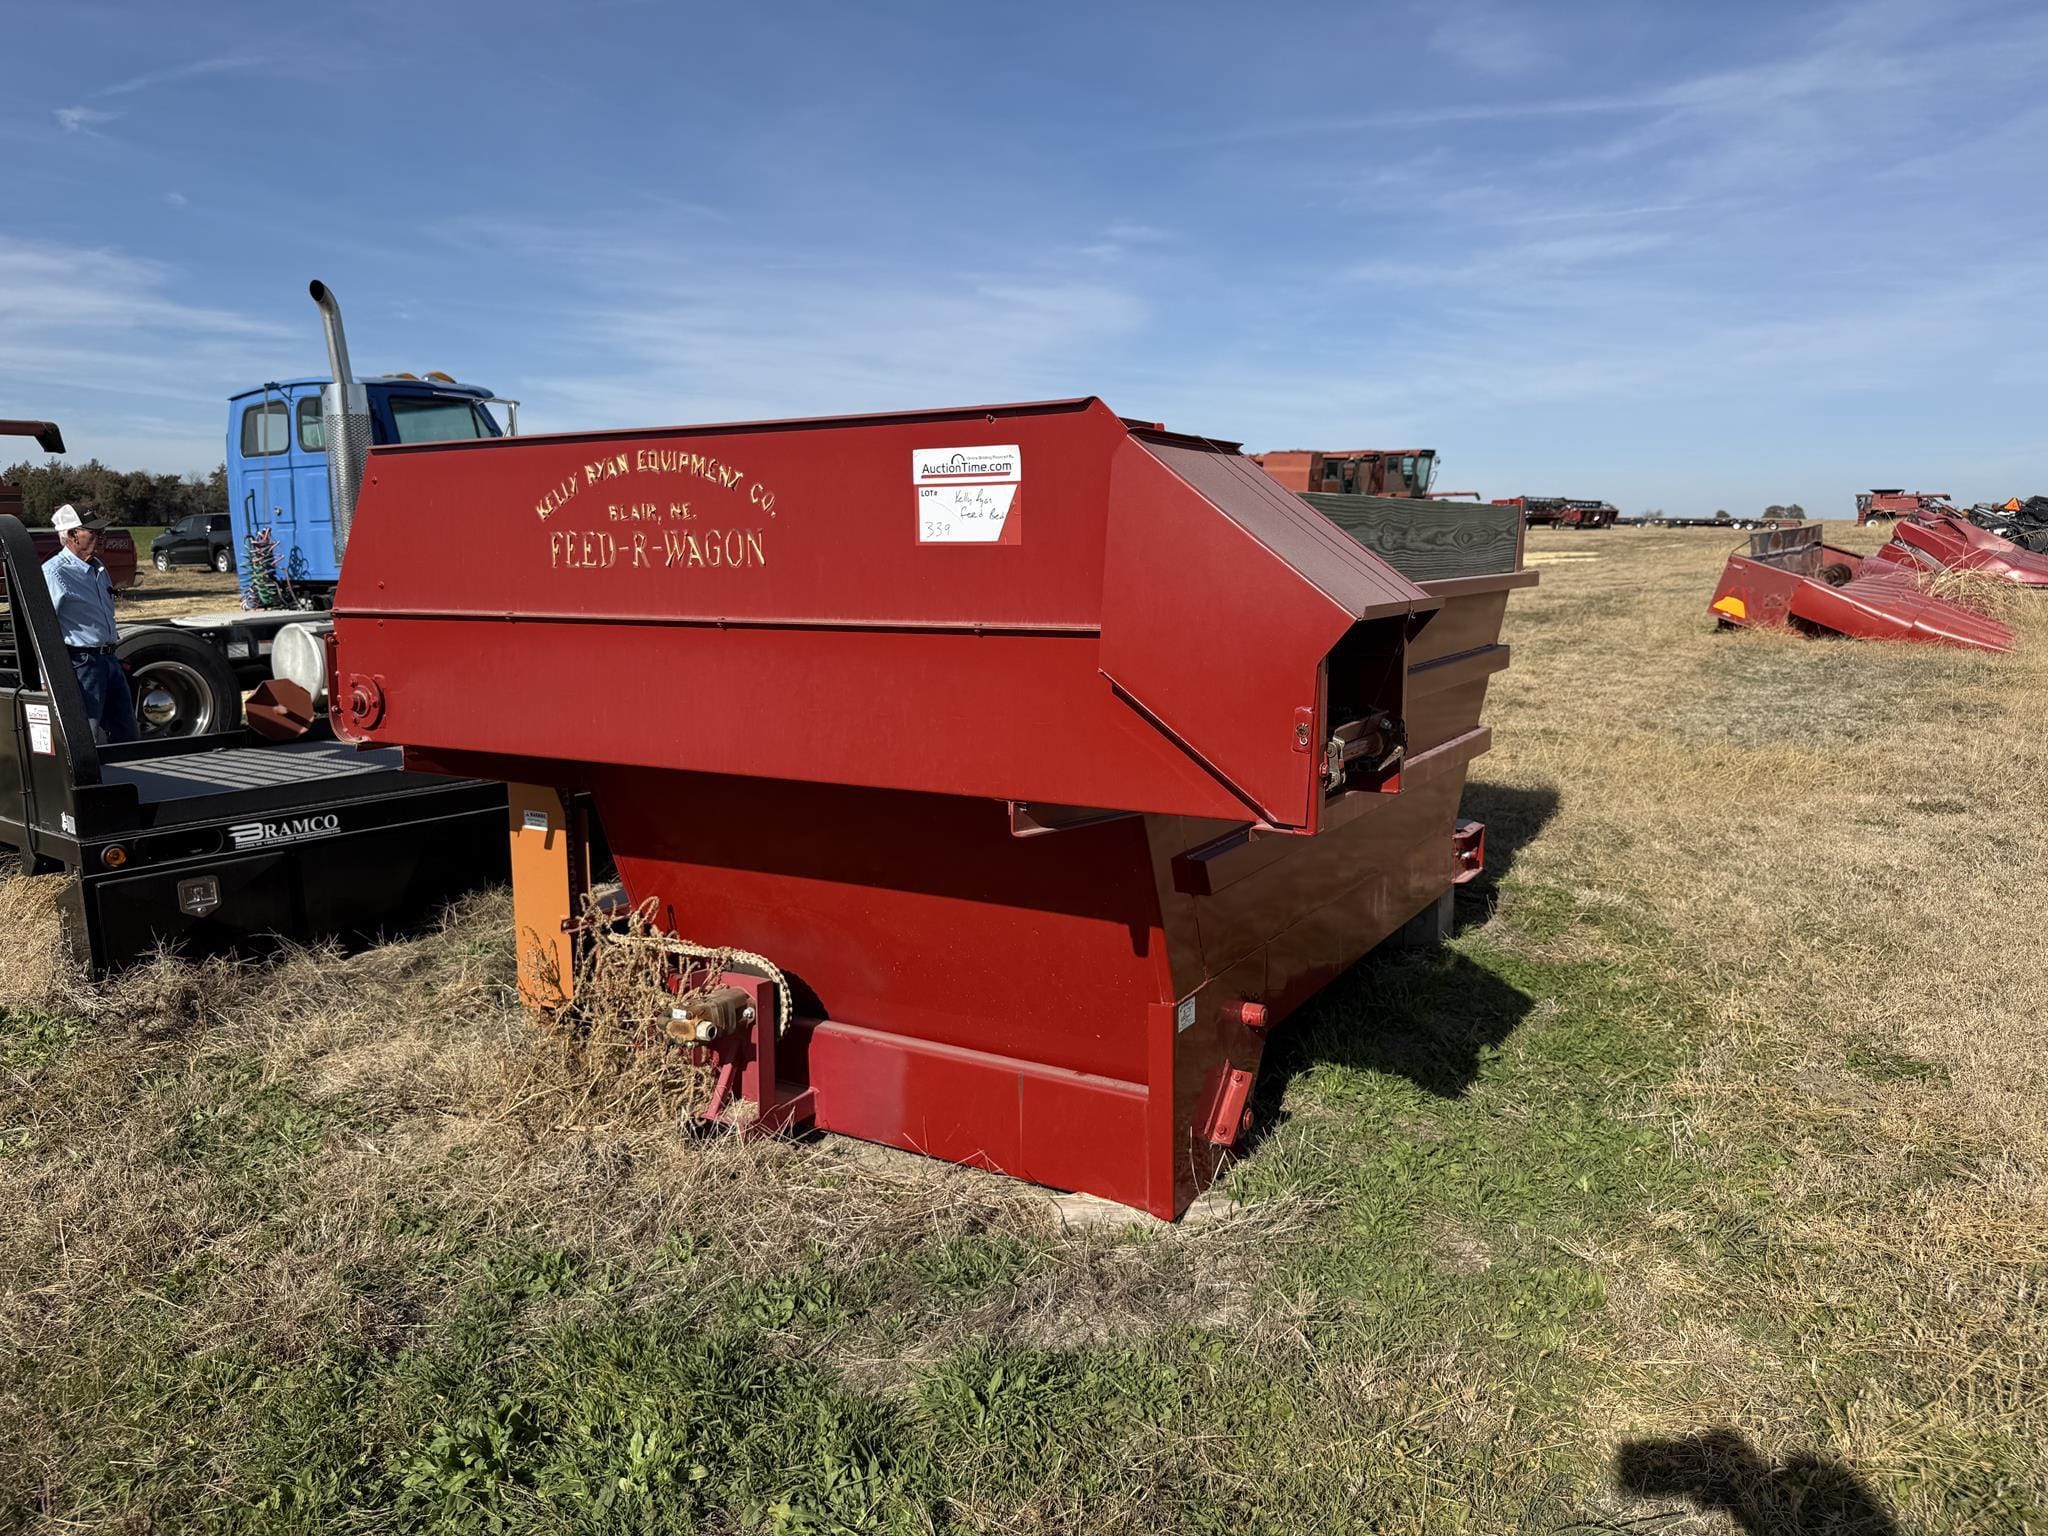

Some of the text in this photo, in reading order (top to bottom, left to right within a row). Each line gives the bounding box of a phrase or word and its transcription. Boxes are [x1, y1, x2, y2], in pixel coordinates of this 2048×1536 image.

[921, 462, 1012, 474] AuctionTime.com
[535, 449, 777, 522] KELLY RYAN EQUIPMENT CO.
[608, 503, 662, 525] BLAIR,
[924, 521, 951, 538] 339
[550, 529, 766, 568] FEED-R-WAGON
[227, 814, 338, 842] BRAMCO
